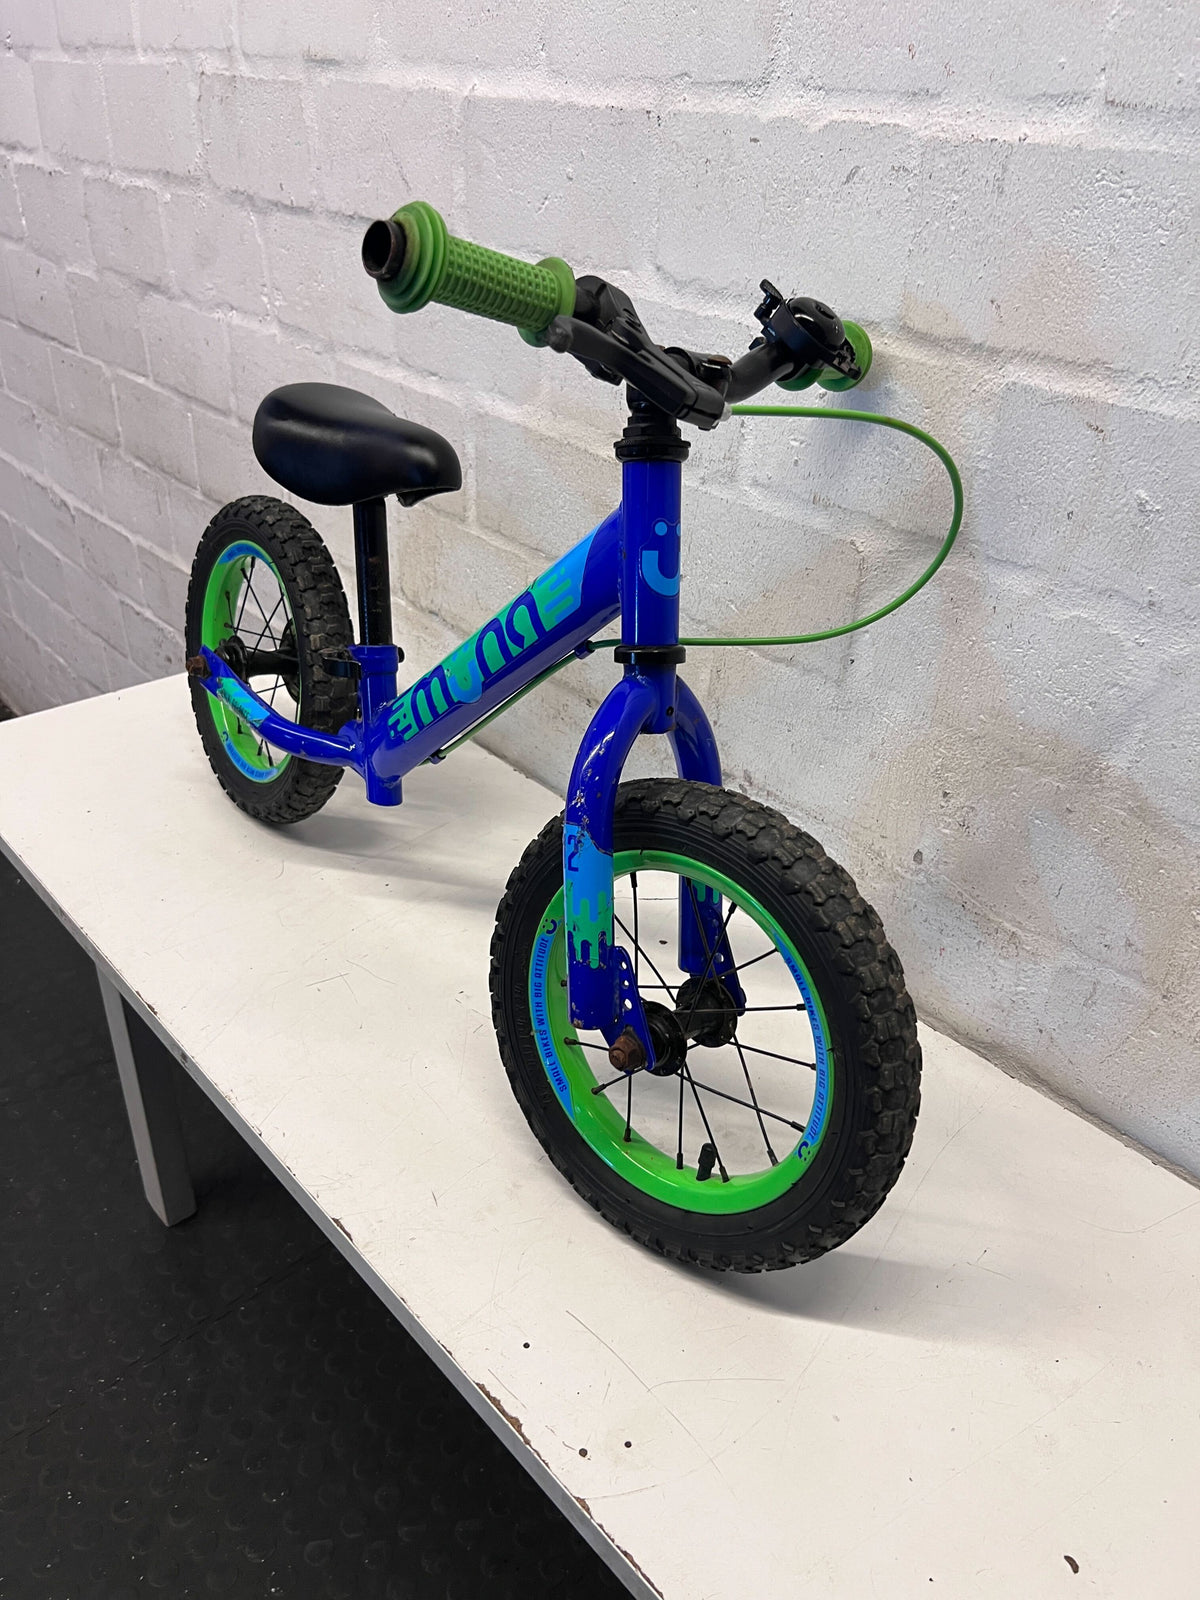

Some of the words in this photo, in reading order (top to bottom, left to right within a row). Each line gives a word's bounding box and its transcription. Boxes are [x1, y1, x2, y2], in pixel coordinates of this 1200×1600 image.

[534, 937, 550, 979] ATTITUDE
[534, 980, 543, 998] BIG
[535, 1001, 546, 1028] WITH
[539, 1029, 553, 1059] BIKES
[815, 1035, 826, 1068] WITH
[547, 1060, 568, 1092] SMALL
[818, 1071, 827, 1090] BIG
[808, 1093, 825, 1140] ATTITUDE
